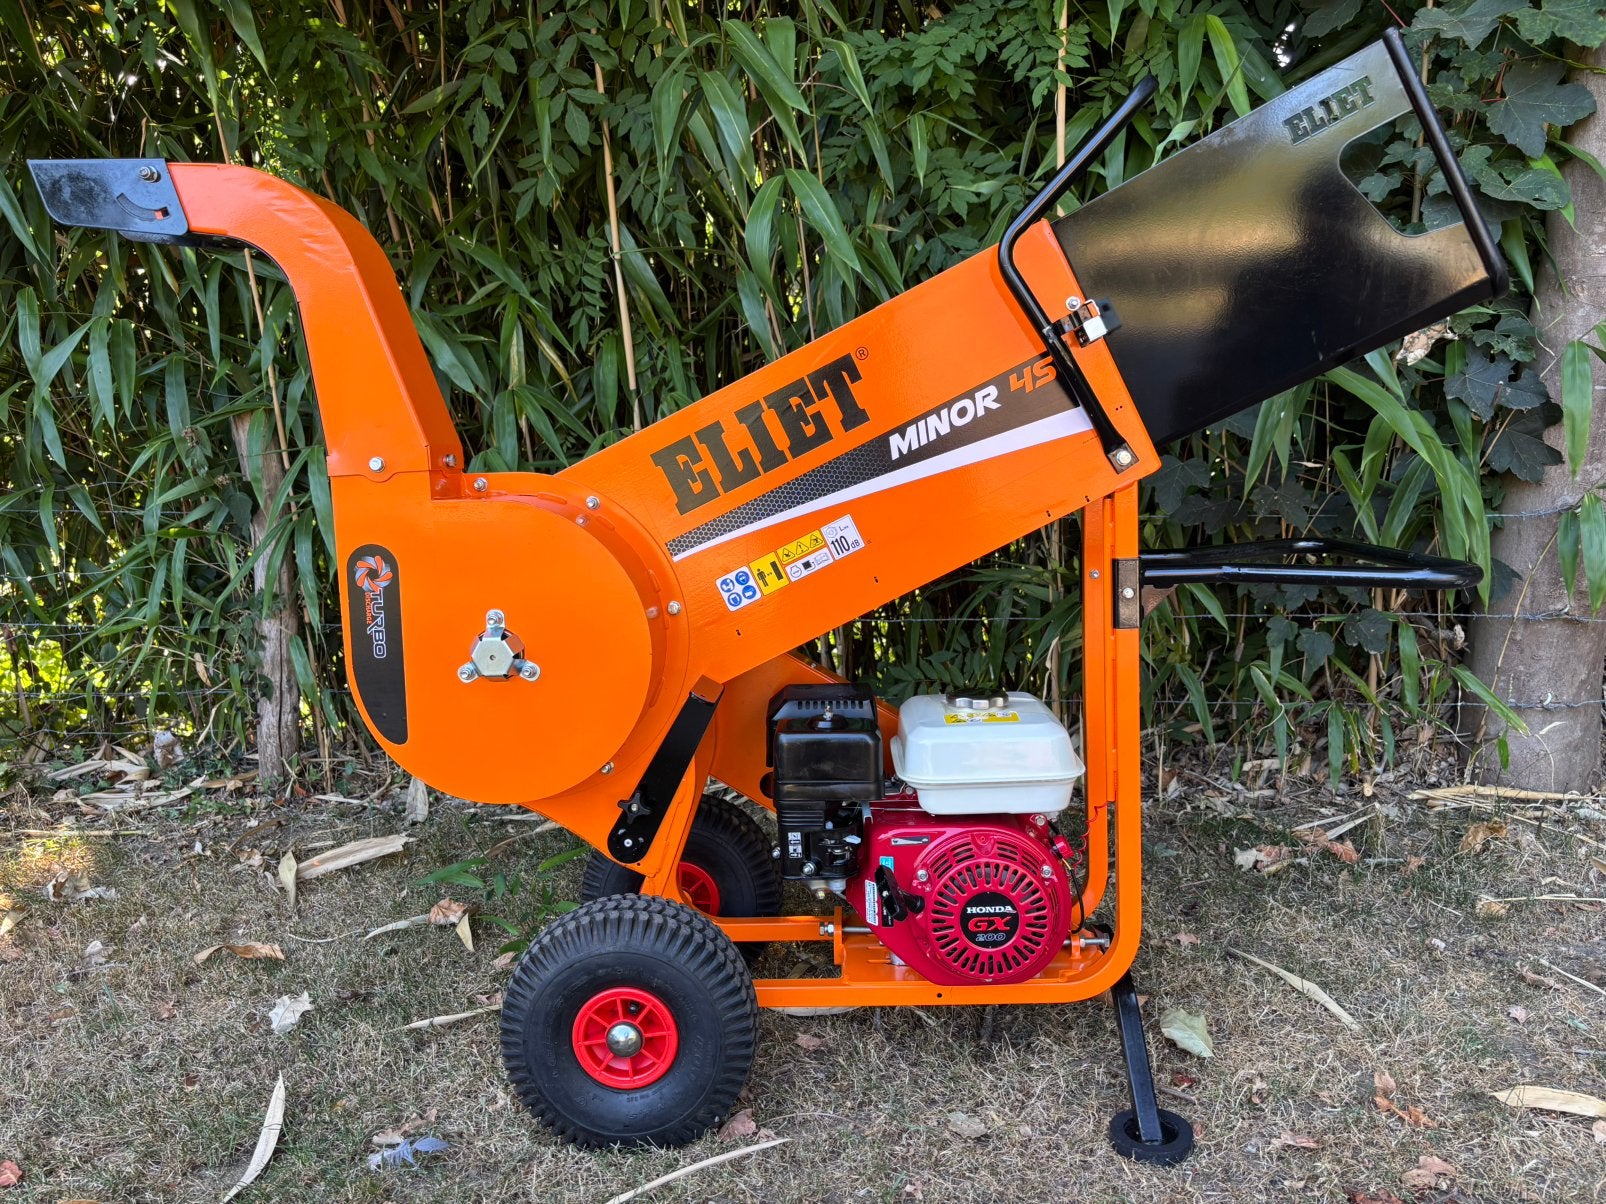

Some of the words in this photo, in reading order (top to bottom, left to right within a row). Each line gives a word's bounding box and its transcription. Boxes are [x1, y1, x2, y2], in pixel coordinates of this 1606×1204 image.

[1282, 75, 1376, 146] ELIET
[889, 384, 1001, 461] MINOR
[830, 535, 851, 556] 110
[850, 539, 861, 549] dB
[364, 591, 373, 625] DISCHARGE
[366, 588, 387, 659] TURBO
[966, 905, 1014, 914] HONDA
[967, 916, 1012, 932] GX
[975, 932, 1006, 942] 200
